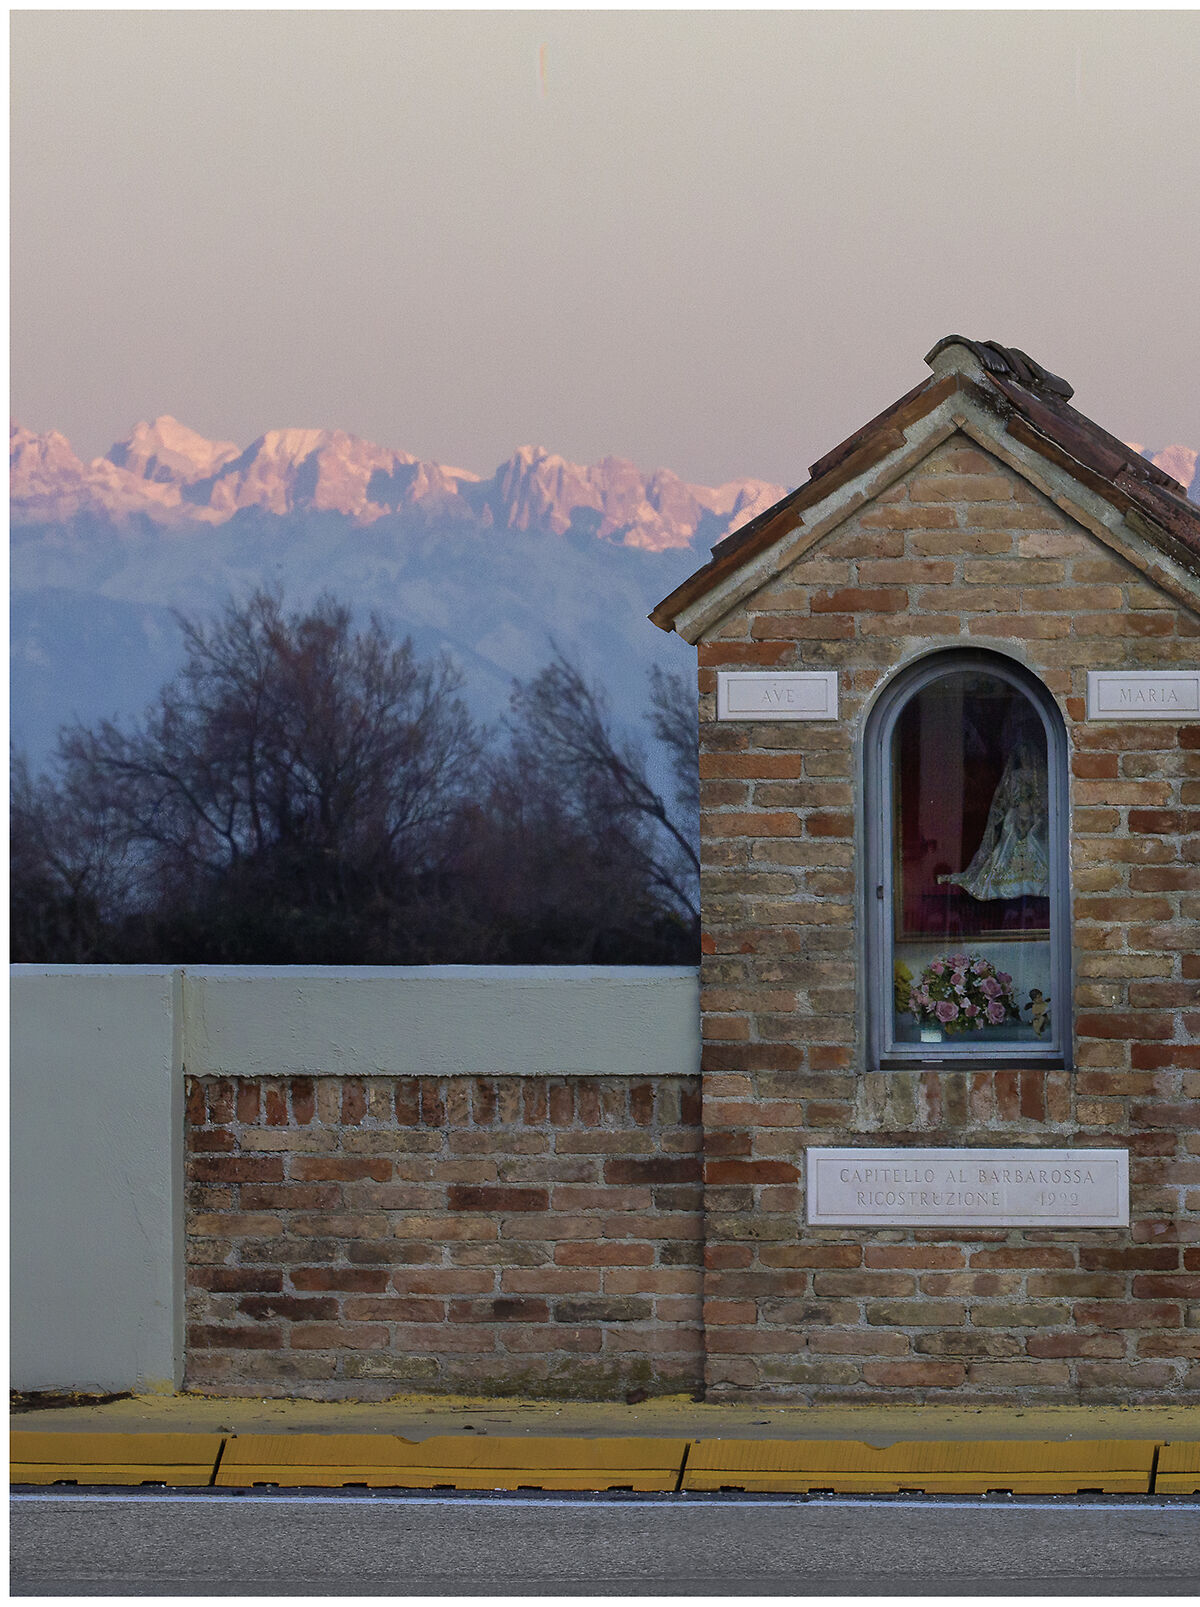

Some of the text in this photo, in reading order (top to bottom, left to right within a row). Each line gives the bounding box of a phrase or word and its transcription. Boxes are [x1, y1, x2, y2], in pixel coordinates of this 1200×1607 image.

[761, 689, 794, 703] AVE
[1120, 688, 1178, 703] MARIA
[839, 1168, 1095, 1184] CAPITELLO AL BARBAROSSA
[857, 1191, 1000, 1207] RICOSTRUZIONE
